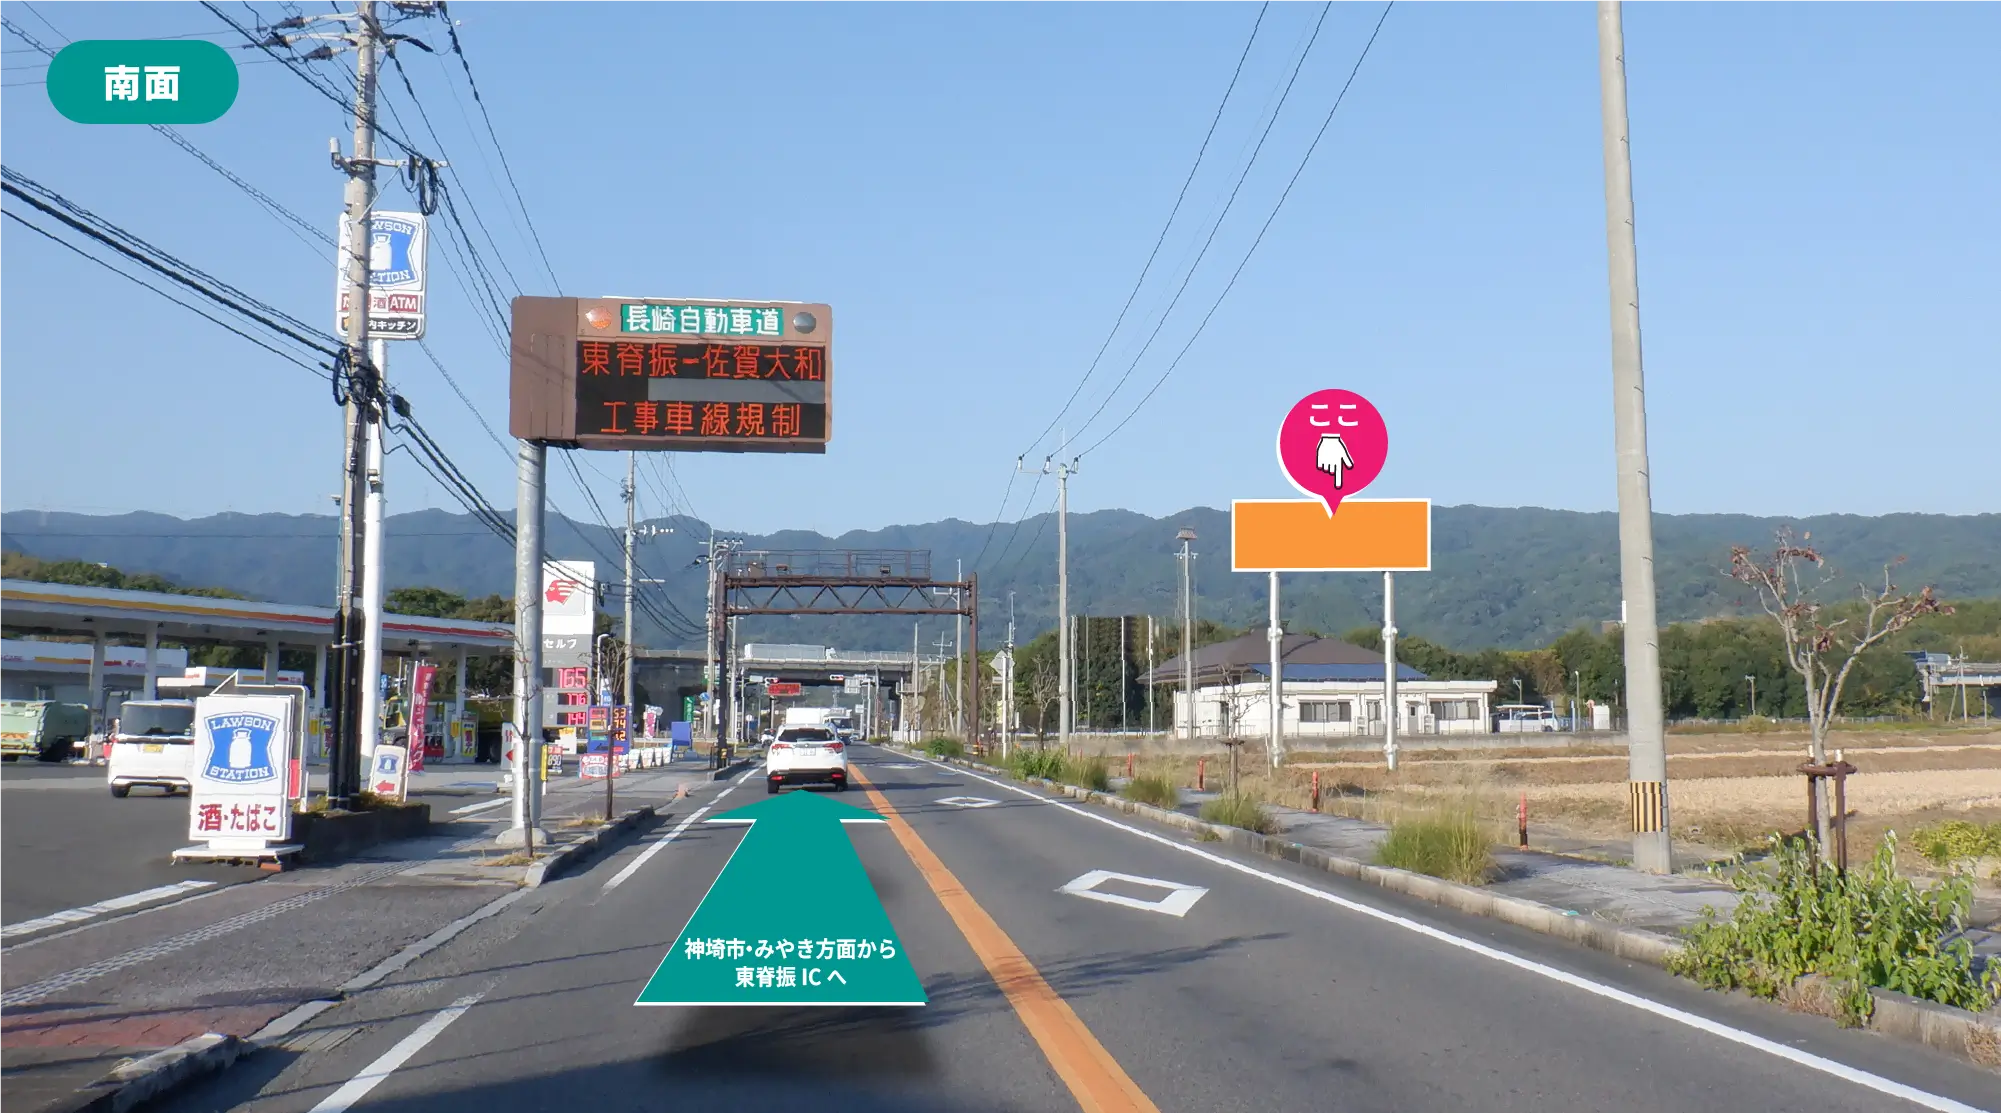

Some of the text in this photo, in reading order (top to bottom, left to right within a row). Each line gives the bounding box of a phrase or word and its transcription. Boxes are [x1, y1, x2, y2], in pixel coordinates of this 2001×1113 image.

[390, 296, 417, 310] ATM
[368, 319, 417, 332] 内キッチン
[626, 305, 780, 336] 長崎自動車道
[601, 401, 801, 437] 工事車線規制
[543, 638, 577, 650] セルフ
[558, 667, 586, 689] 165
[567, 693, 586, 706] 176
[211, 716, 273, 731] LAWSON
[567, 712, 586, 725] 144
[209, 766, 270, 780] STATION
[198, 803, 277, 832] 酒・たばこ
